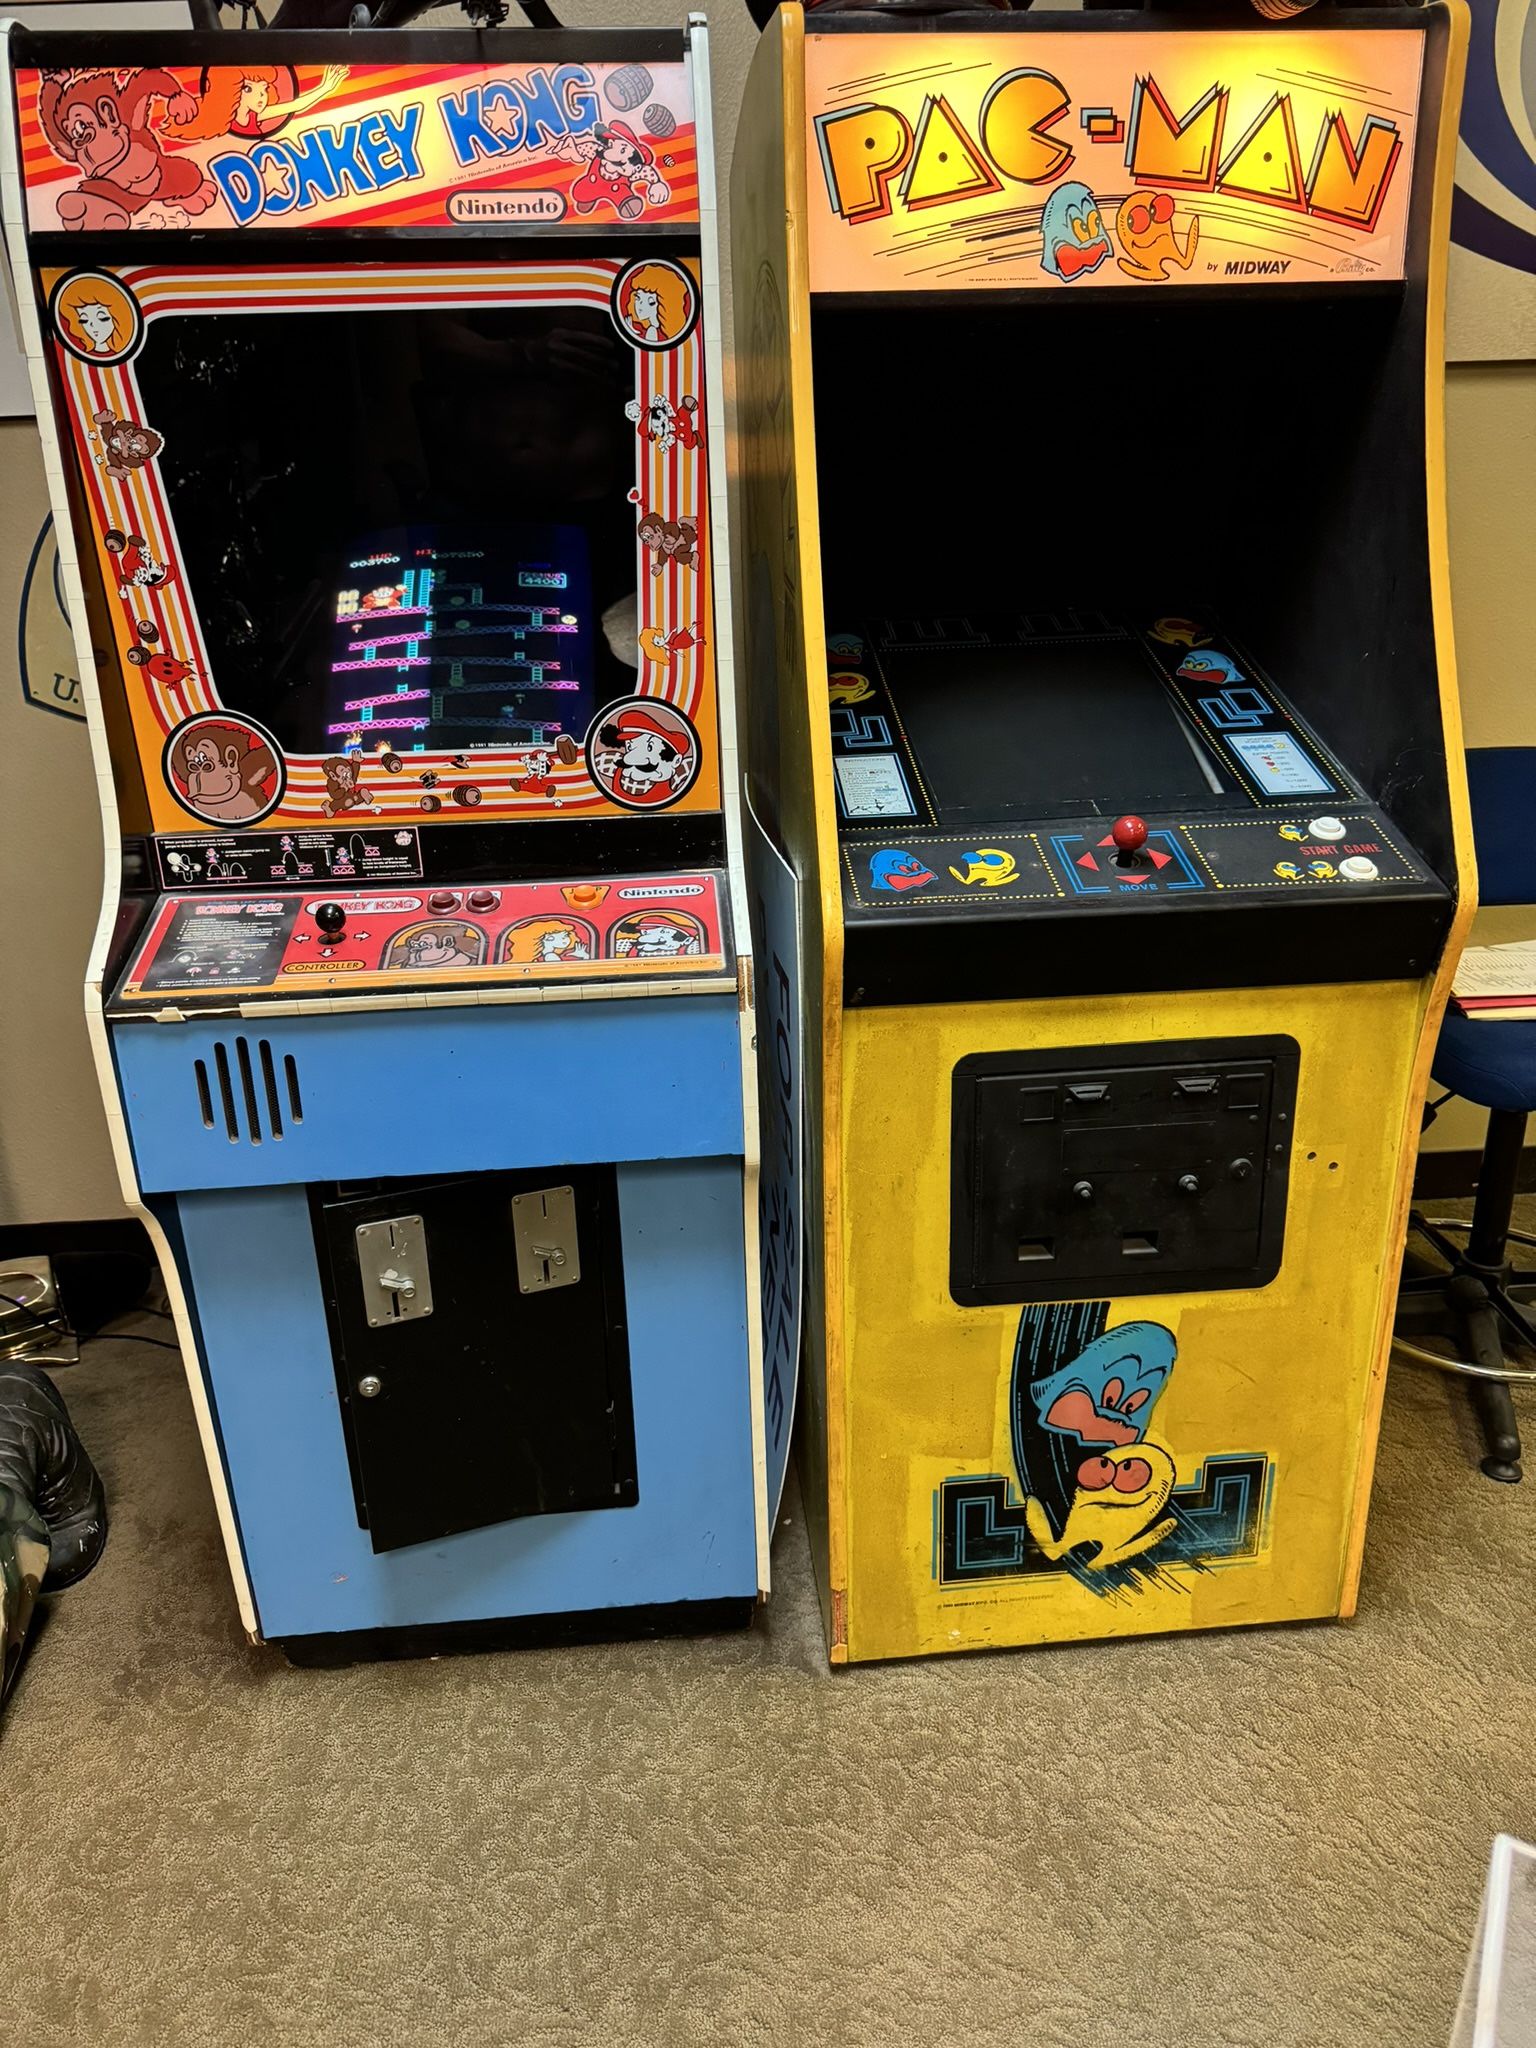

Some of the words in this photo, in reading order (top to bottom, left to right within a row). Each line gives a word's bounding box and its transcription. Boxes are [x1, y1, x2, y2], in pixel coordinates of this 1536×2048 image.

[209, 102, 425, 227] DONKEY
[438, 62, 601, 167] KONG
[814, 67, 1403, 233] PAC-MAN
[456, 198, 559, 215] Nintendo
[1206, 262, 1219, 272] by
[1224, 260, 1292, 275] MIDWAY
[1300, 845, 1339, 856] START
[1344, 843, 1384, 855] GAME
[623, 886, 701, 897] Nintendo
[1119, 883, 1158, 893] MOVE
[374, 899, 415, 910] KONG
[286, 962, 360, 972] CONTROLLER
